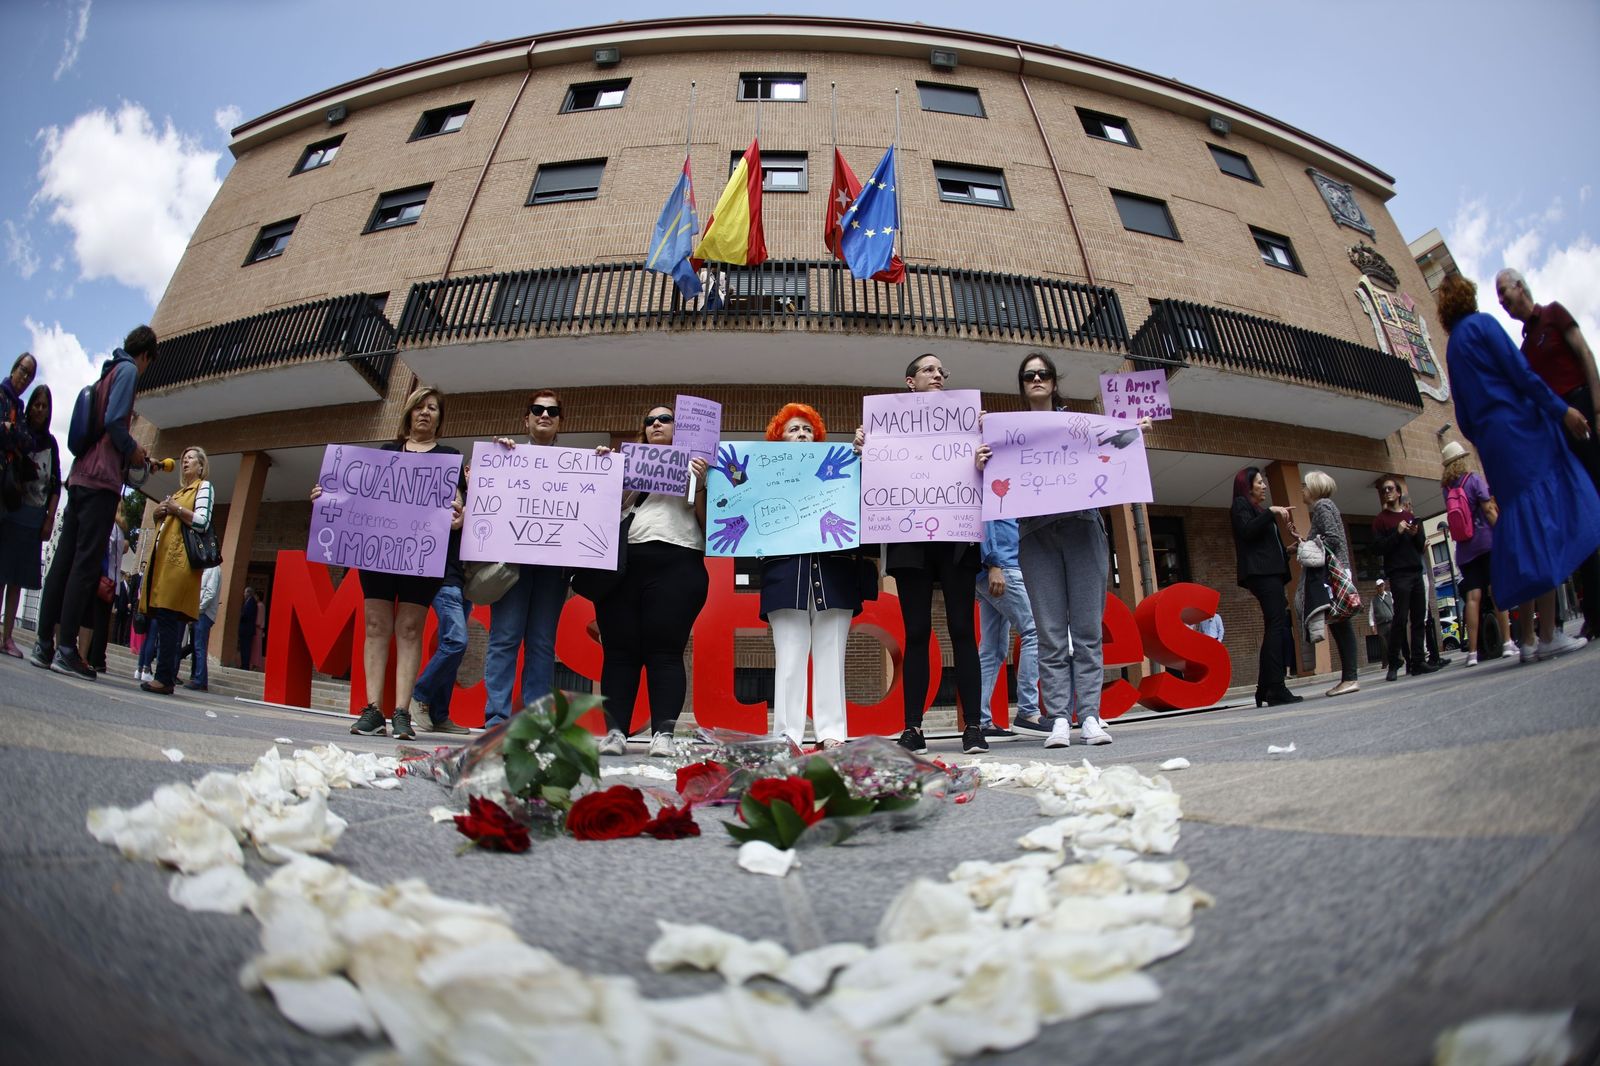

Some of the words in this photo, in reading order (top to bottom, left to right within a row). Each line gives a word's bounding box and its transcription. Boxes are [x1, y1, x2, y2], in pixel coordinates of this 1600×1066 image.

[1107, 378, 1118, 392] El
[1126, 378, 1160, 393] Amor
[916, 397, 928, 405] EL
[622, 445, 635, 457] SI
[639, 446, 689, 467] TOCAN
[867, 445, 909, 462] SÓLO
[931, 442, 973, 461] CURA
[480, 454, 529, 468] SOMOS
[535, 458, 548, 469] EL
[558, 452, 612, 471] GRITO
[320, 448, 459, 509] ¿CUÁNTAS
[635, 462, 664, 477] UNA
[667, 467, 688, 483] NOS
[776, 468, 785, 477] ni
[910, 472, 930, 480] CON
[1020, 472, 1078, 490] SOLAS
[478, 477, 495, 488] DE
[508, 479, 531, 490] LAS
[543, 482, 568, 492] QUE
[580, 483, 596, 494] YA
[623, 477, 653, 490] OCAN
[473, 495, 502, 513] NO
[516, 497, 579, 518] TIENEN
[347, 502, 398, 530] tenemos
[411, 520, 432, 537] que
[509, 520, 564, 544] VOZ
[946, 530, 983, 539] QUEREMOS
